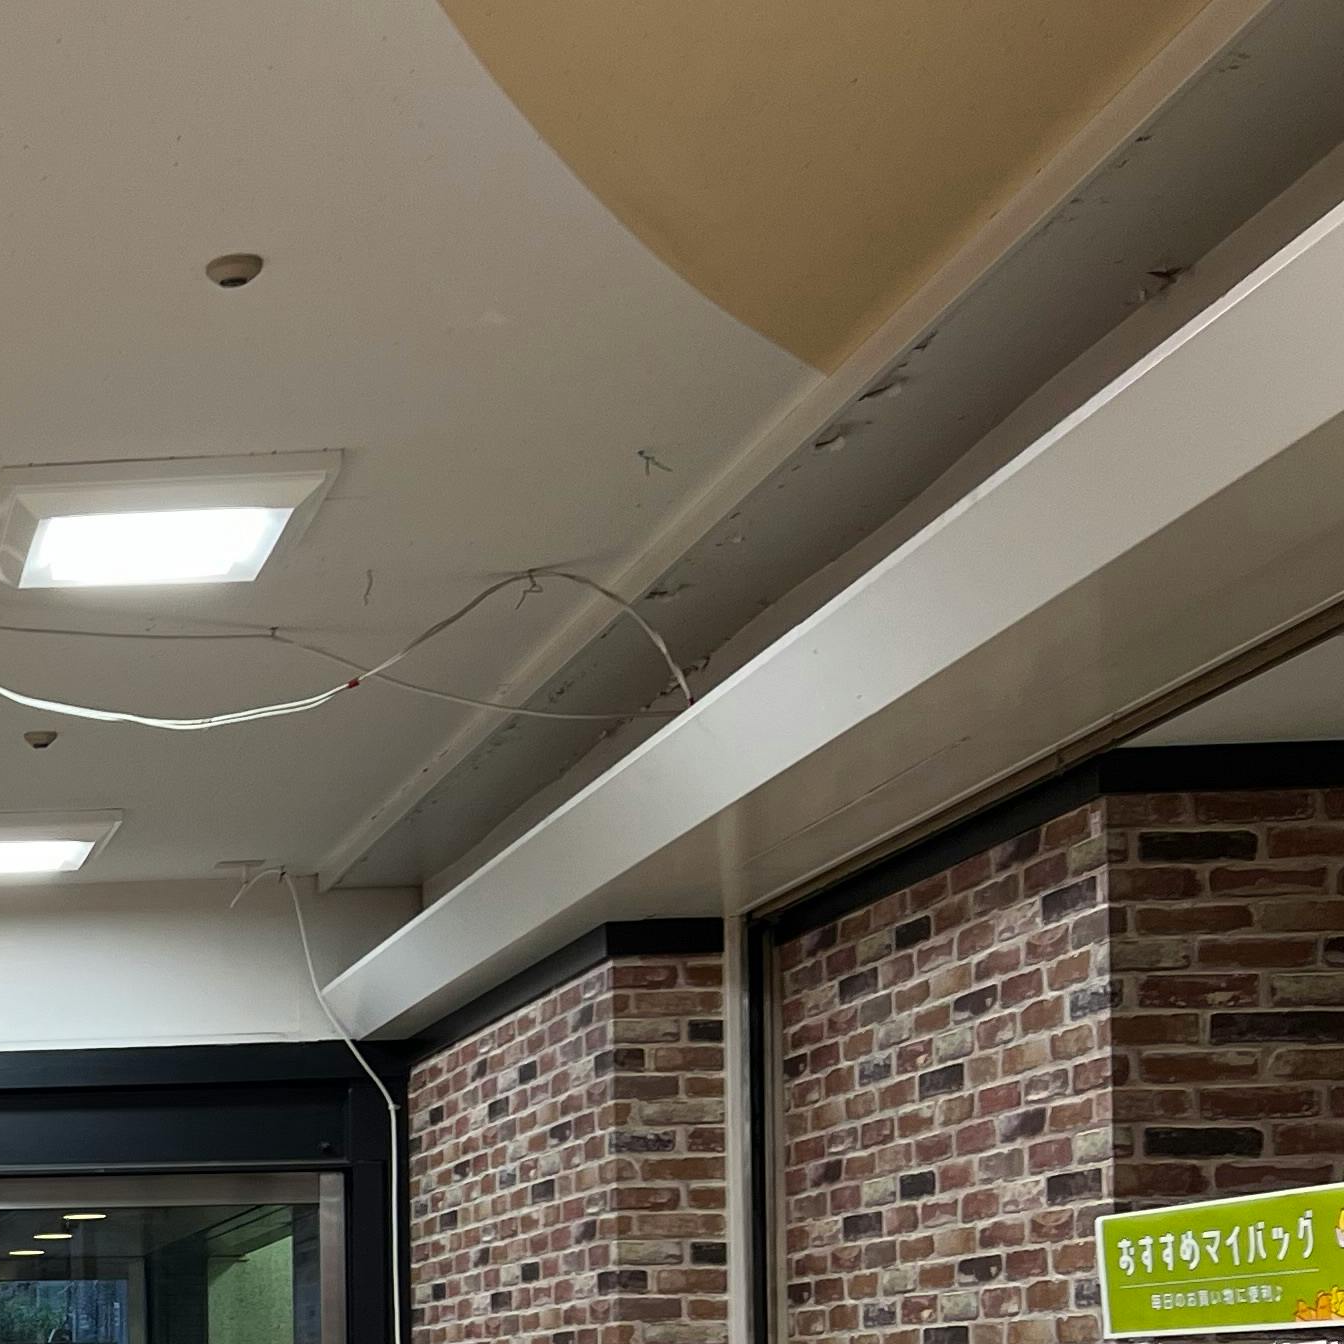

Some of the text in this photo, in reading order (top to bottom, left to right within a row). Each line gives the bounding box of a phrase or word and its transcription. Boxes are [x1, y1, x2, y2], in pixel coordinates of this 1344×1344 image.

[1117, 1209, 1314, 1276] おすすめマイバッグ
